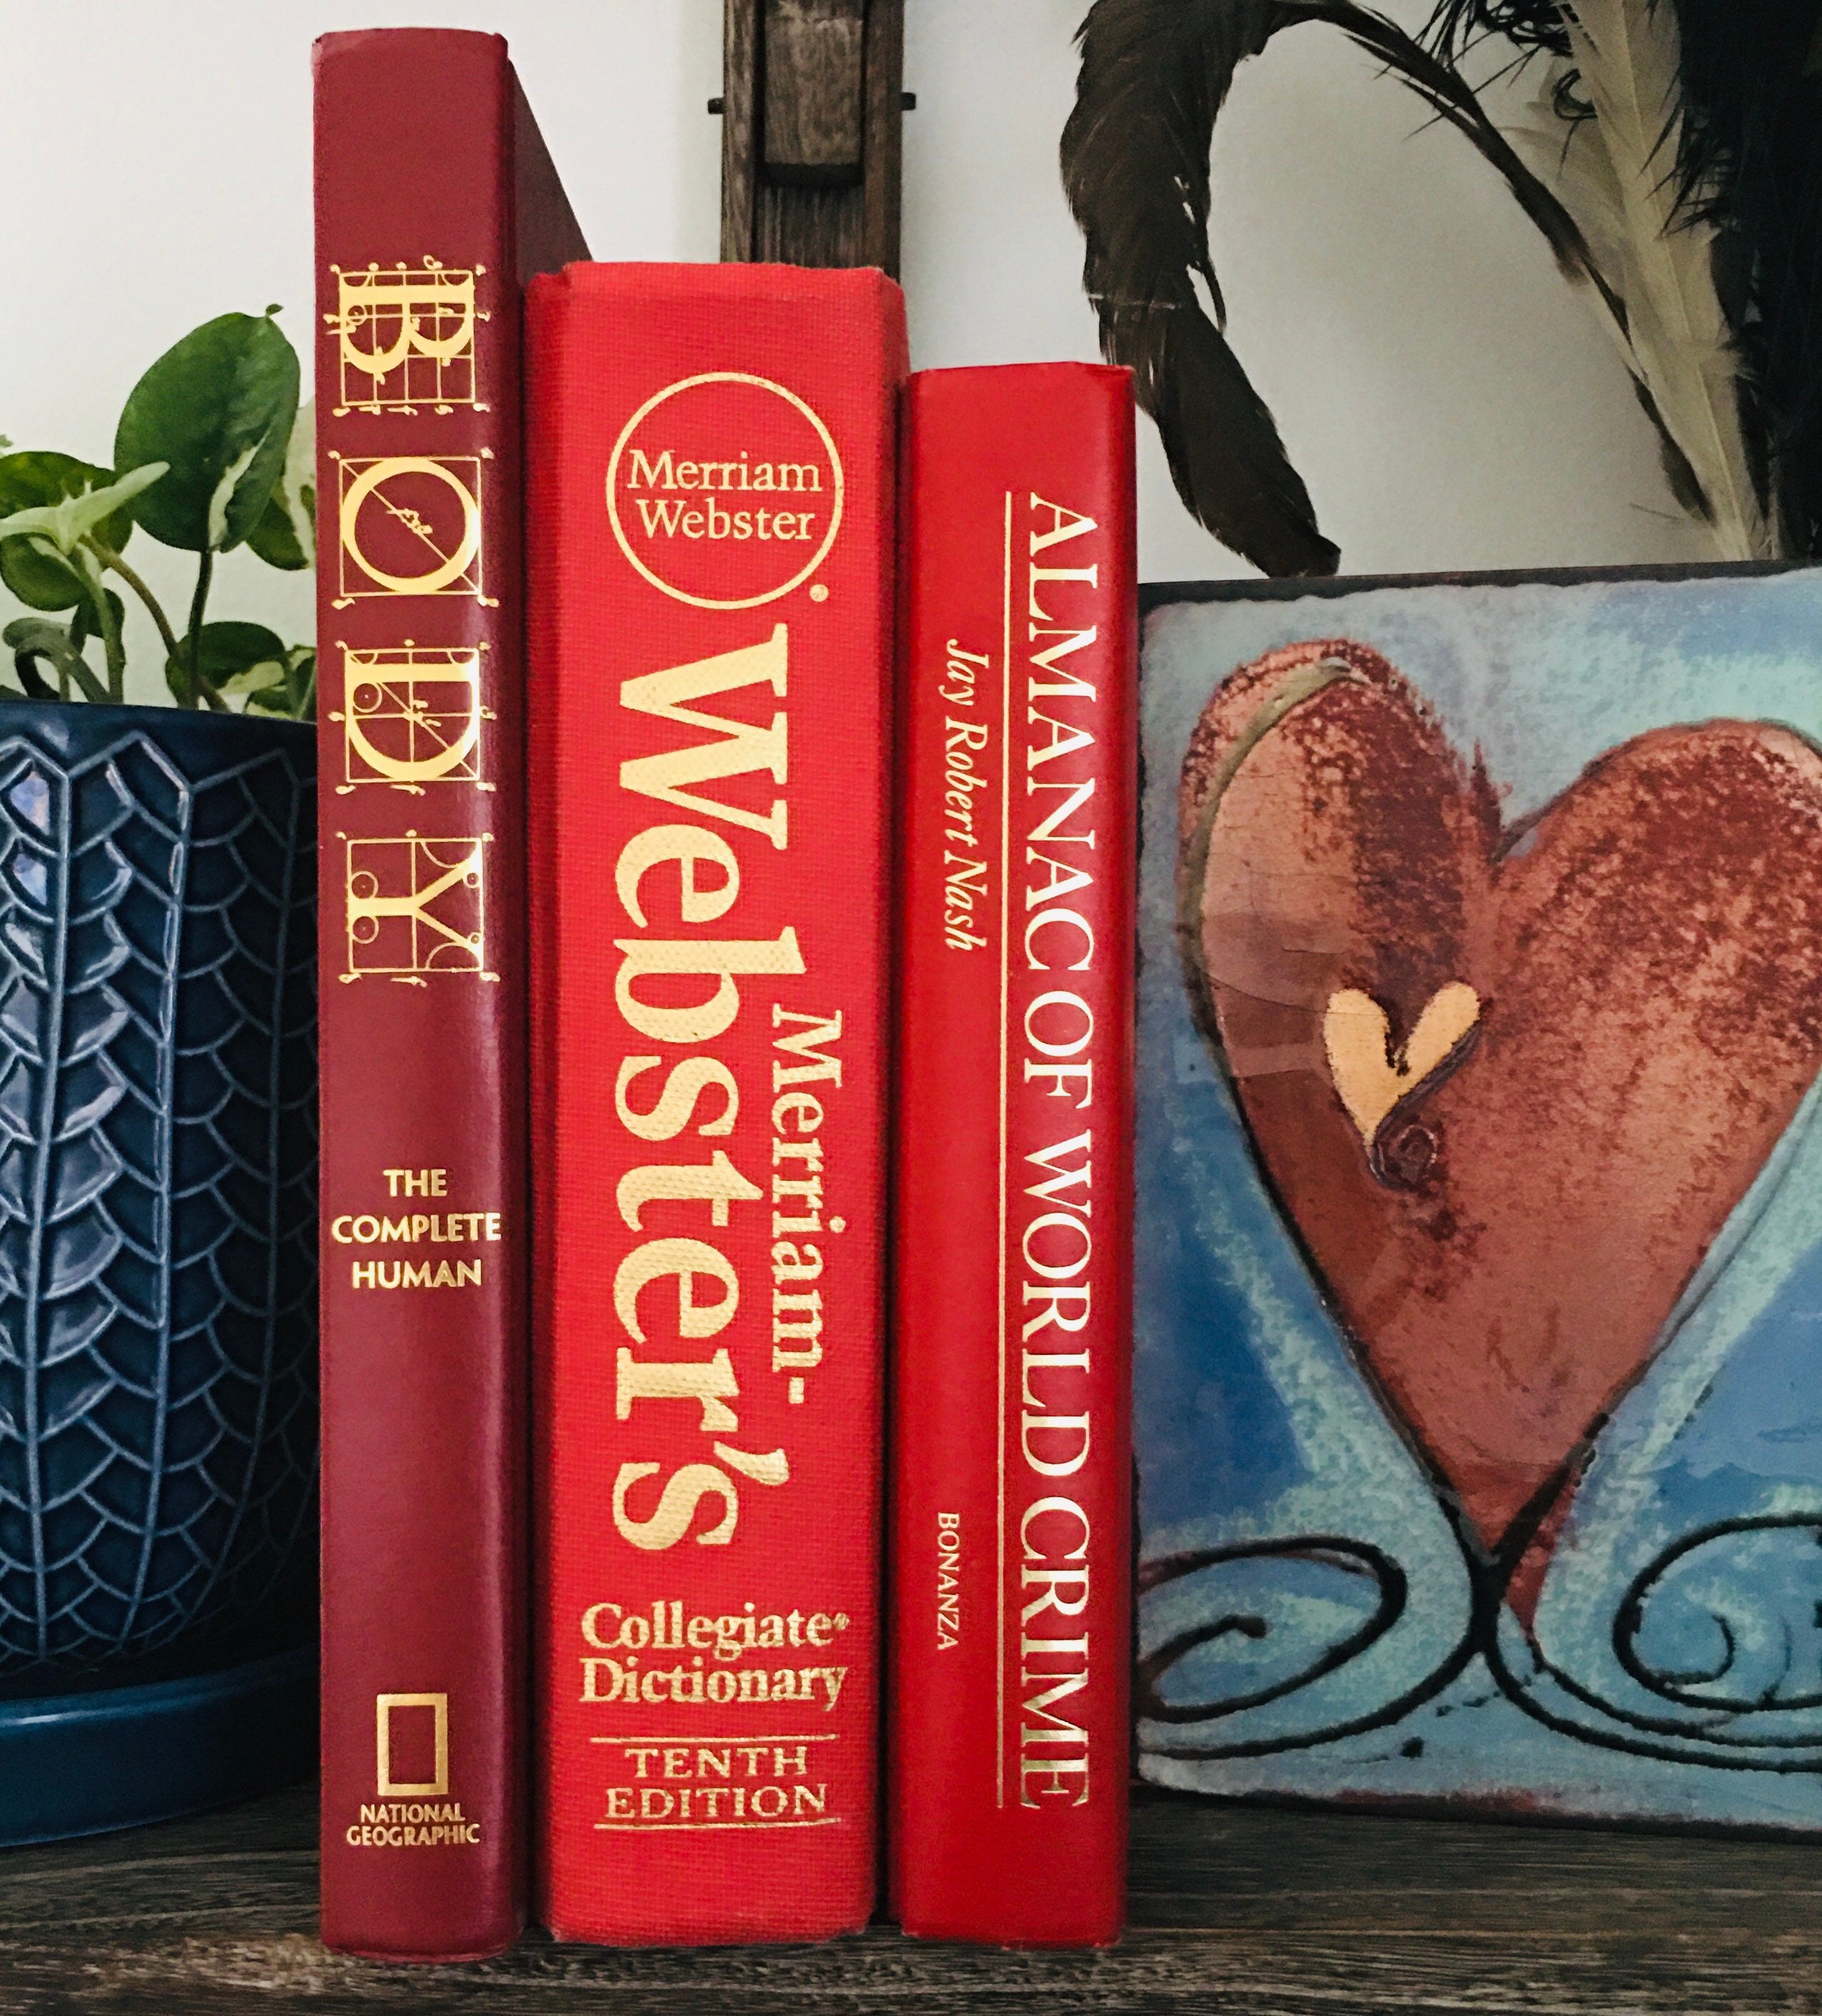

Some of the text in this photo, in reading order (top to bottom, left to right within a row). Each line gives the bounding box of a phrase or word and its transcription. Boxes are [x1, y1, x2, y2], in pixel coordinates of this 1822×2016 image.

[627, 450, 822, 492] Merriam
[635, 497, 815, 540] Webster
[329, 260, 494, 982] BODY
[939, 639, 989, 950] Jay Robert Nash
[612, 623, 806, 1549] Webster's
[1021, 492, 1097, 1809] ALMANAC OF WORLD CRIME
[383, 1169, 447, 1197] THE
[772, 1003, 845, 1404] Merriam-
[332, 1213, 501, 1243] COMPLETE
[352, 1259, 481, 1288] HUMAN
[937, 1513, 960, 1649] BONANZA
[579, 1655, 847, 1711] Dictionary
[625, 1747, 807, 1778] TENTH
[361, 1803, 465, 1823] NATIONAL
[606, 1784, 828, 1818] EDITION
[347, 1822, 479, 1846] GEOGRAPHIC
